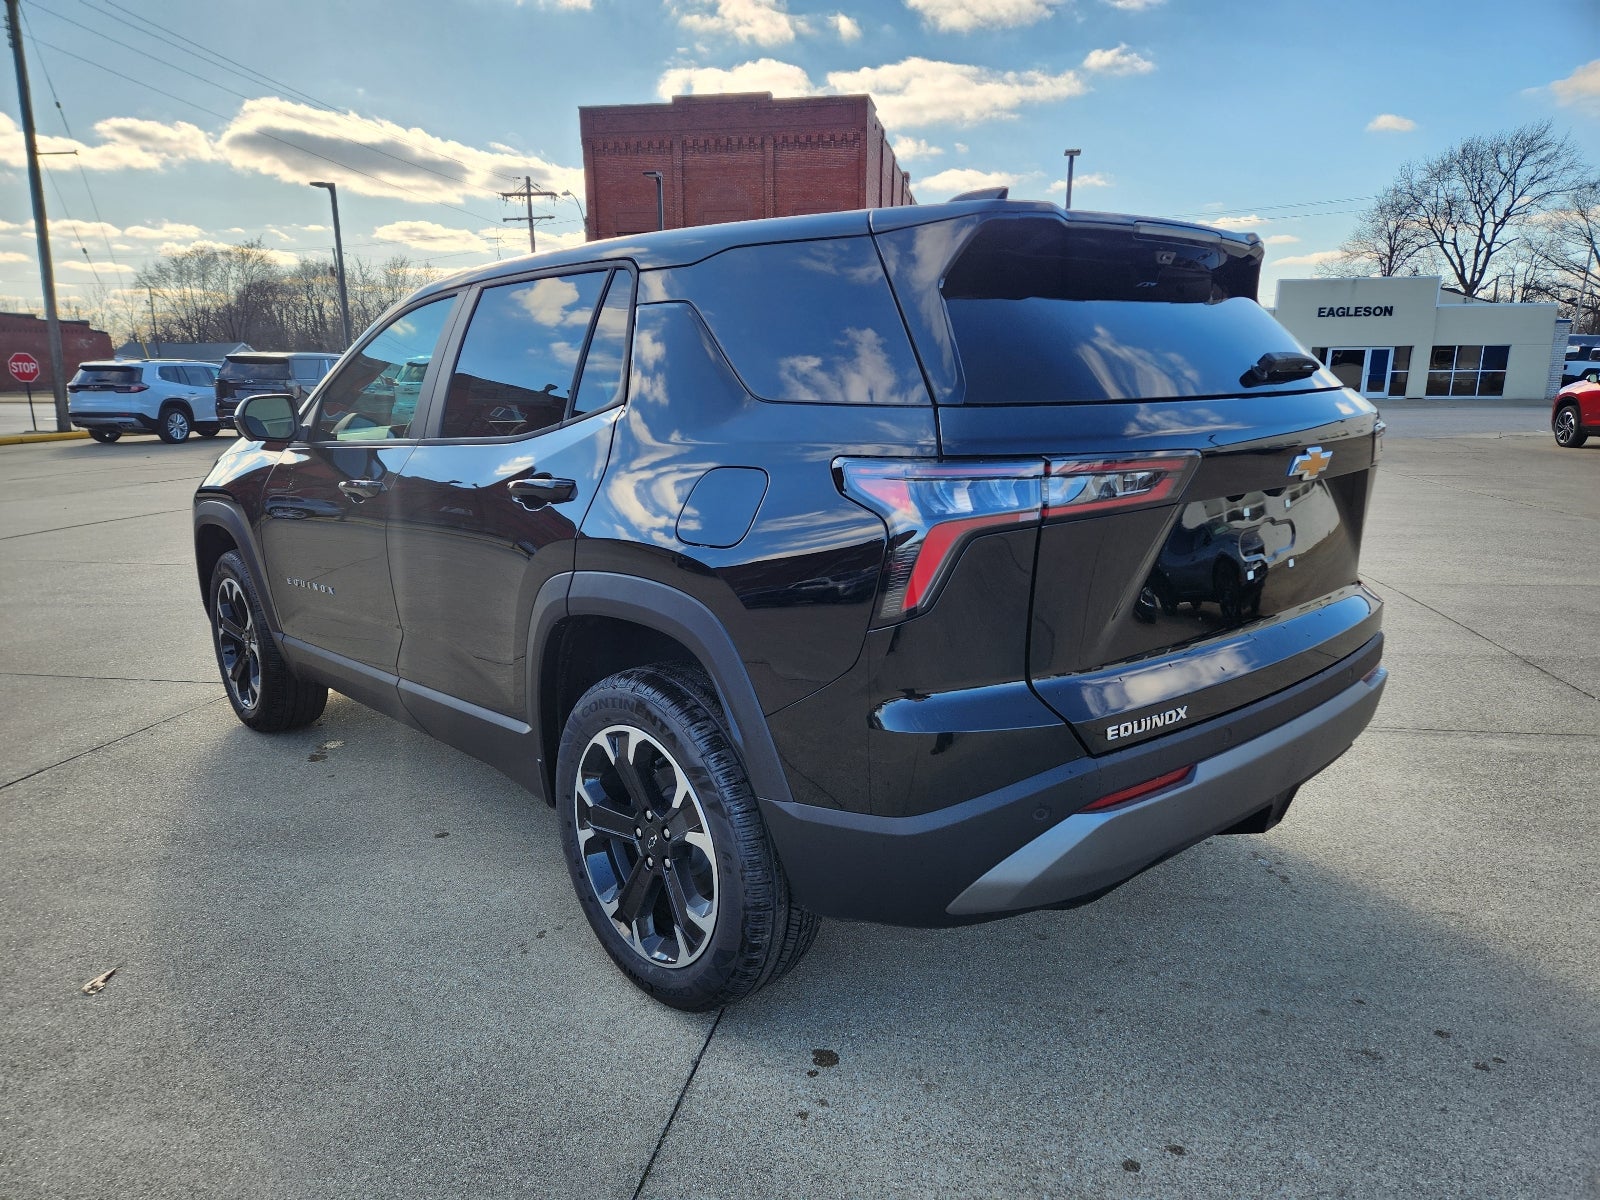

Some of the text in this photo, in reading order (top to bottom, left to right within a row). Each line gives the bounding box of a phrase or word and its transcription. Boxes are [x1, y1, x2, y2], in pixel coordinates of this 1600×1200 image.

[1317, 305, 1394, 318] EAGLESON
[11, 361, 36, 373] STOP
[286, 577, 336, 596] EQUINOX
[1106, 705, 1188, 741] EQUINOX
